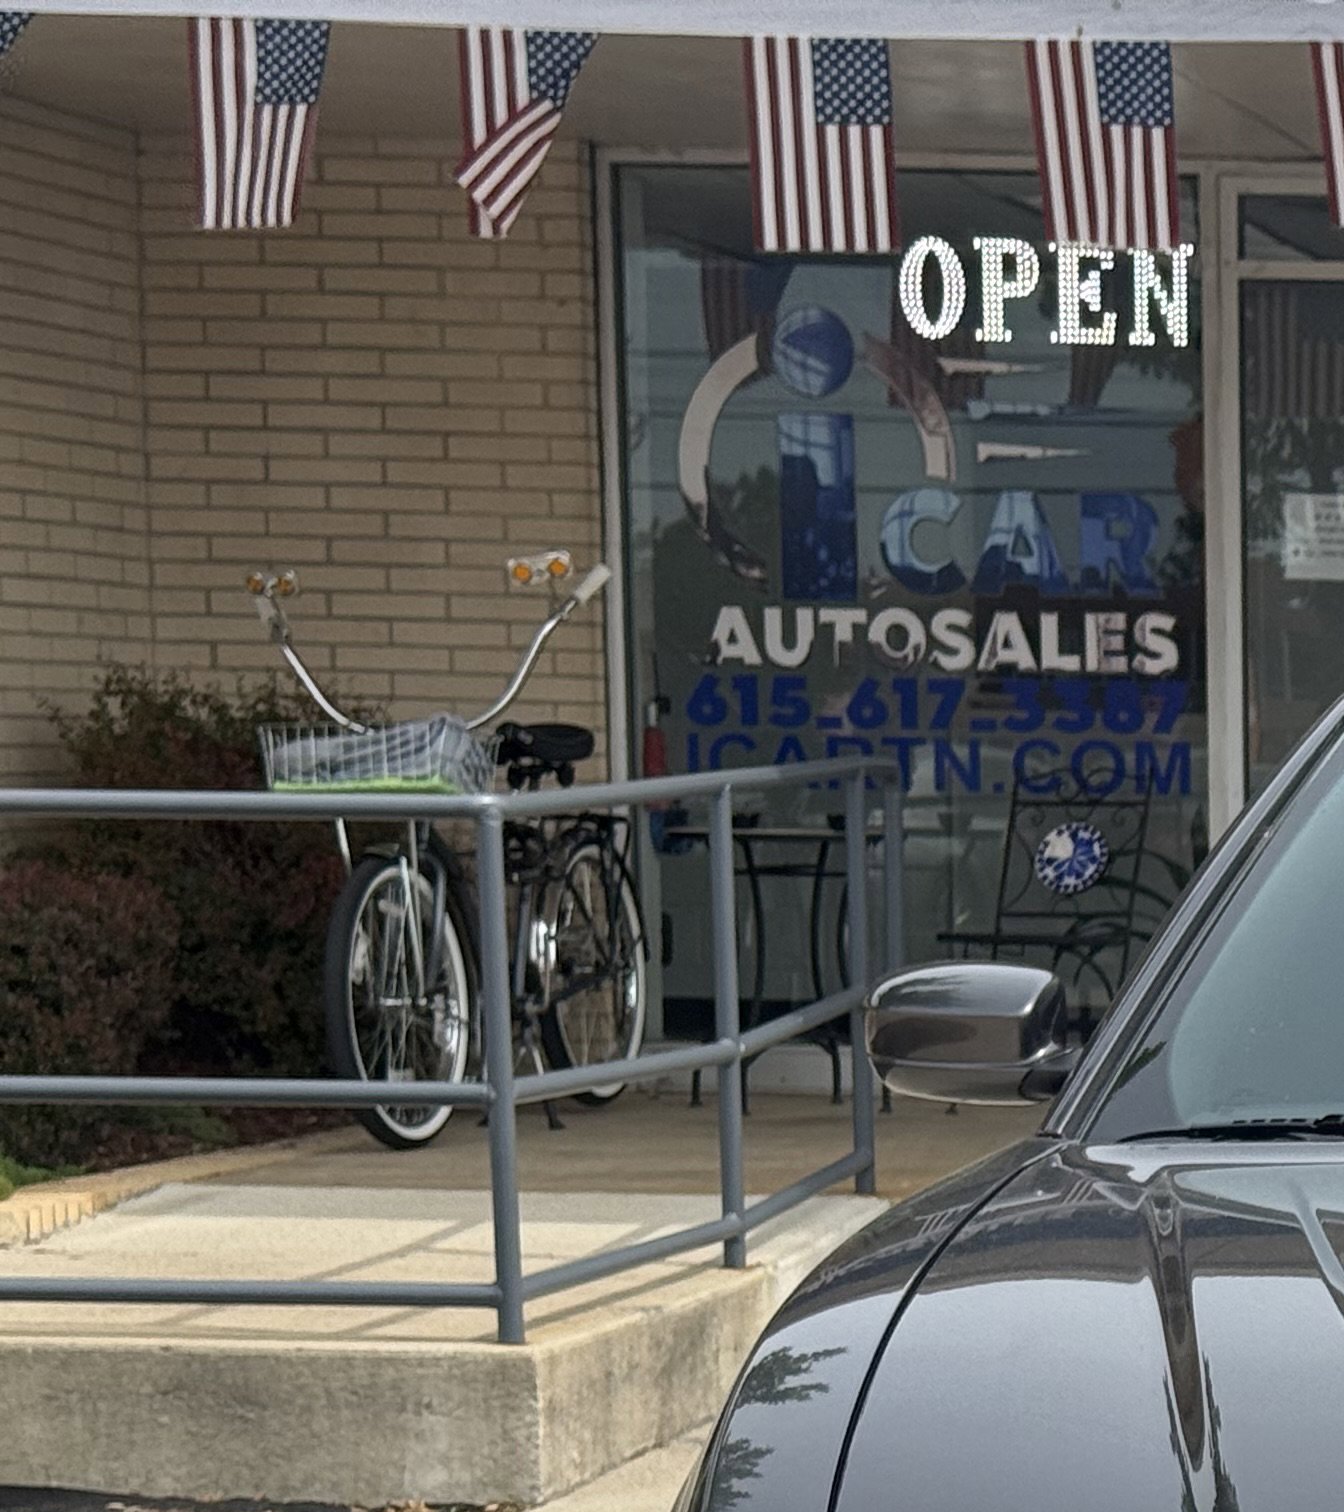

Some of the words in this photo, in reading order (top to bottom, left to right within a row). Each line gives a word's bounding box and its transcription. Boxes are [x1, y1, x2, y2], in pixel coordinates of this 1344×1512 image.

[899, 235, 1194, 346] OPEN
[880, 490, 1162, 596] CAR
[711, 605, 1179, 674] AUTOSALES
